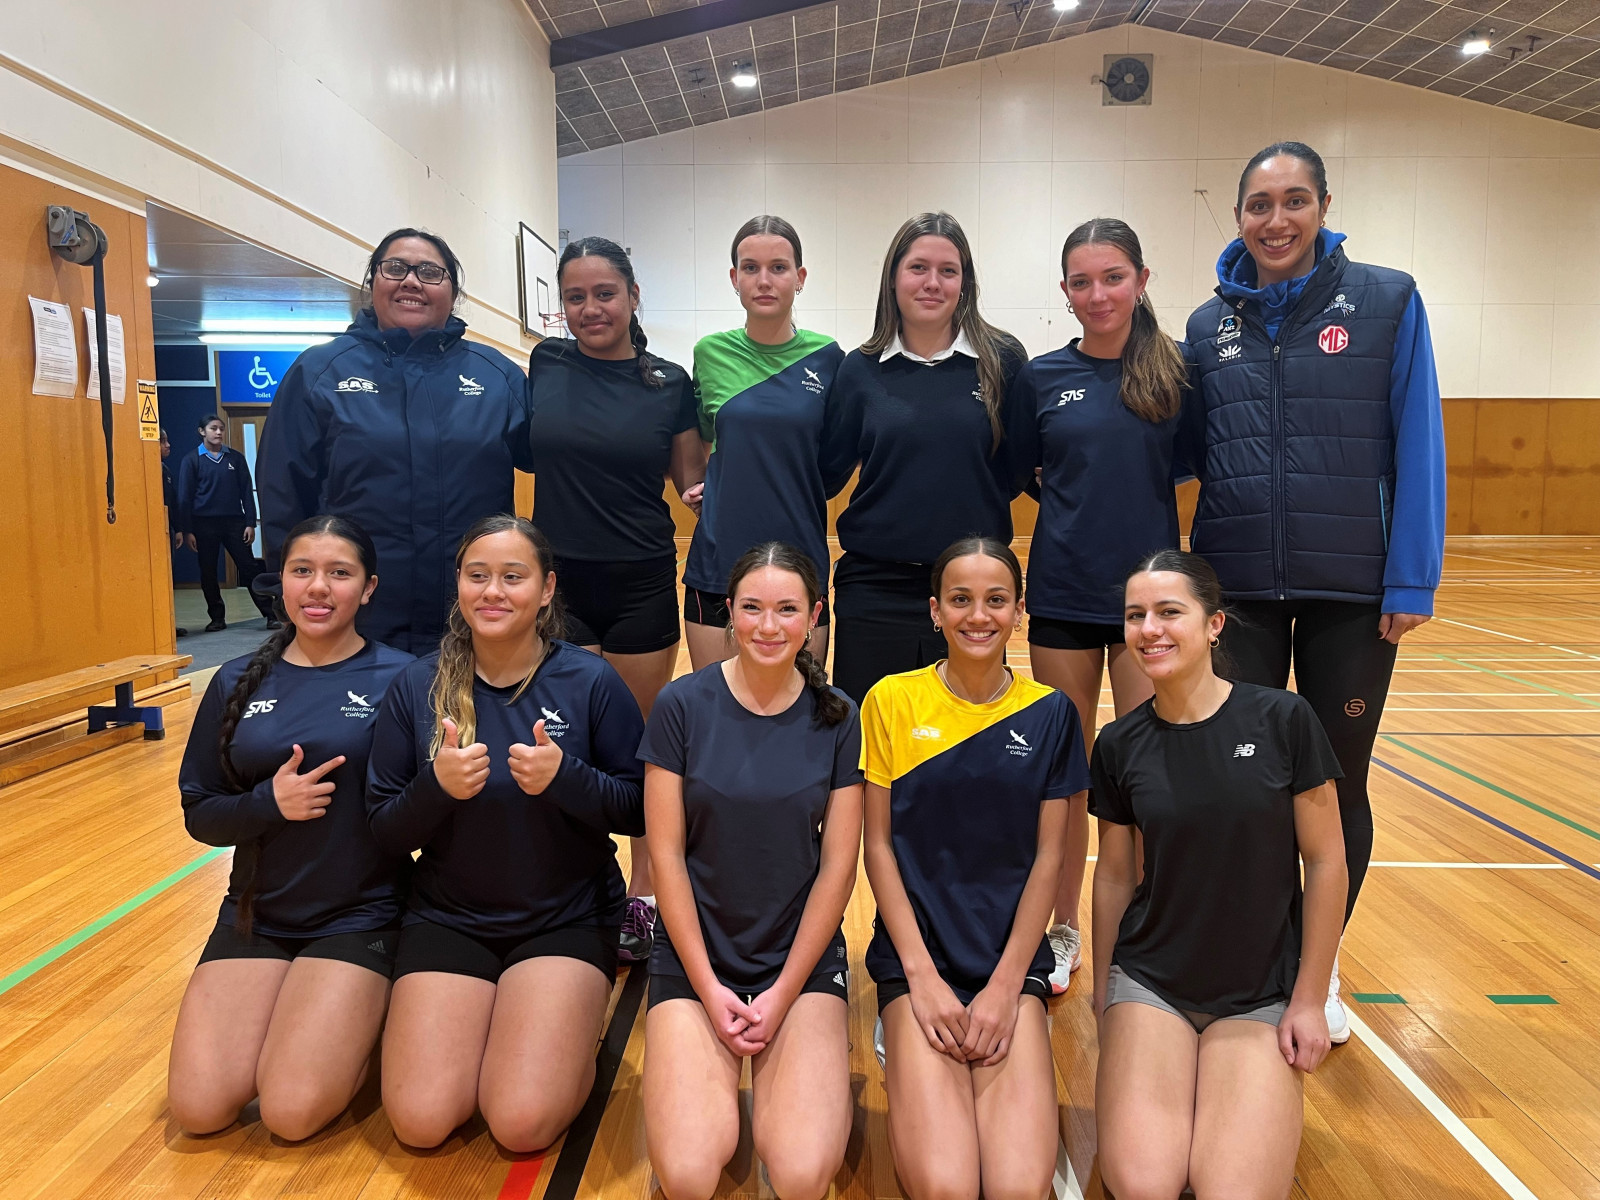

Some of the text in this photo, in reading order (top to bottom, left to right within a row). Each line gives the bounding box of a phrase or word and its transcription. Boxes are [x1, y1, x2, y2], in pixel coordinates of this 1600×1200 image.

[1320, 327, 1347, 352] MG
[338, 380, 374, 390] SAS
[1057, 388, 1086, 406] SAS
[243, 699, 278, 719] SAS
[340, 706, 376, 714] Rutherford
[344, 711, 370, 719] College
[547, 730, 565, 738] ollege
[911, 728, 940, 738] SAS
[1009, 749, 1029, 757] College
